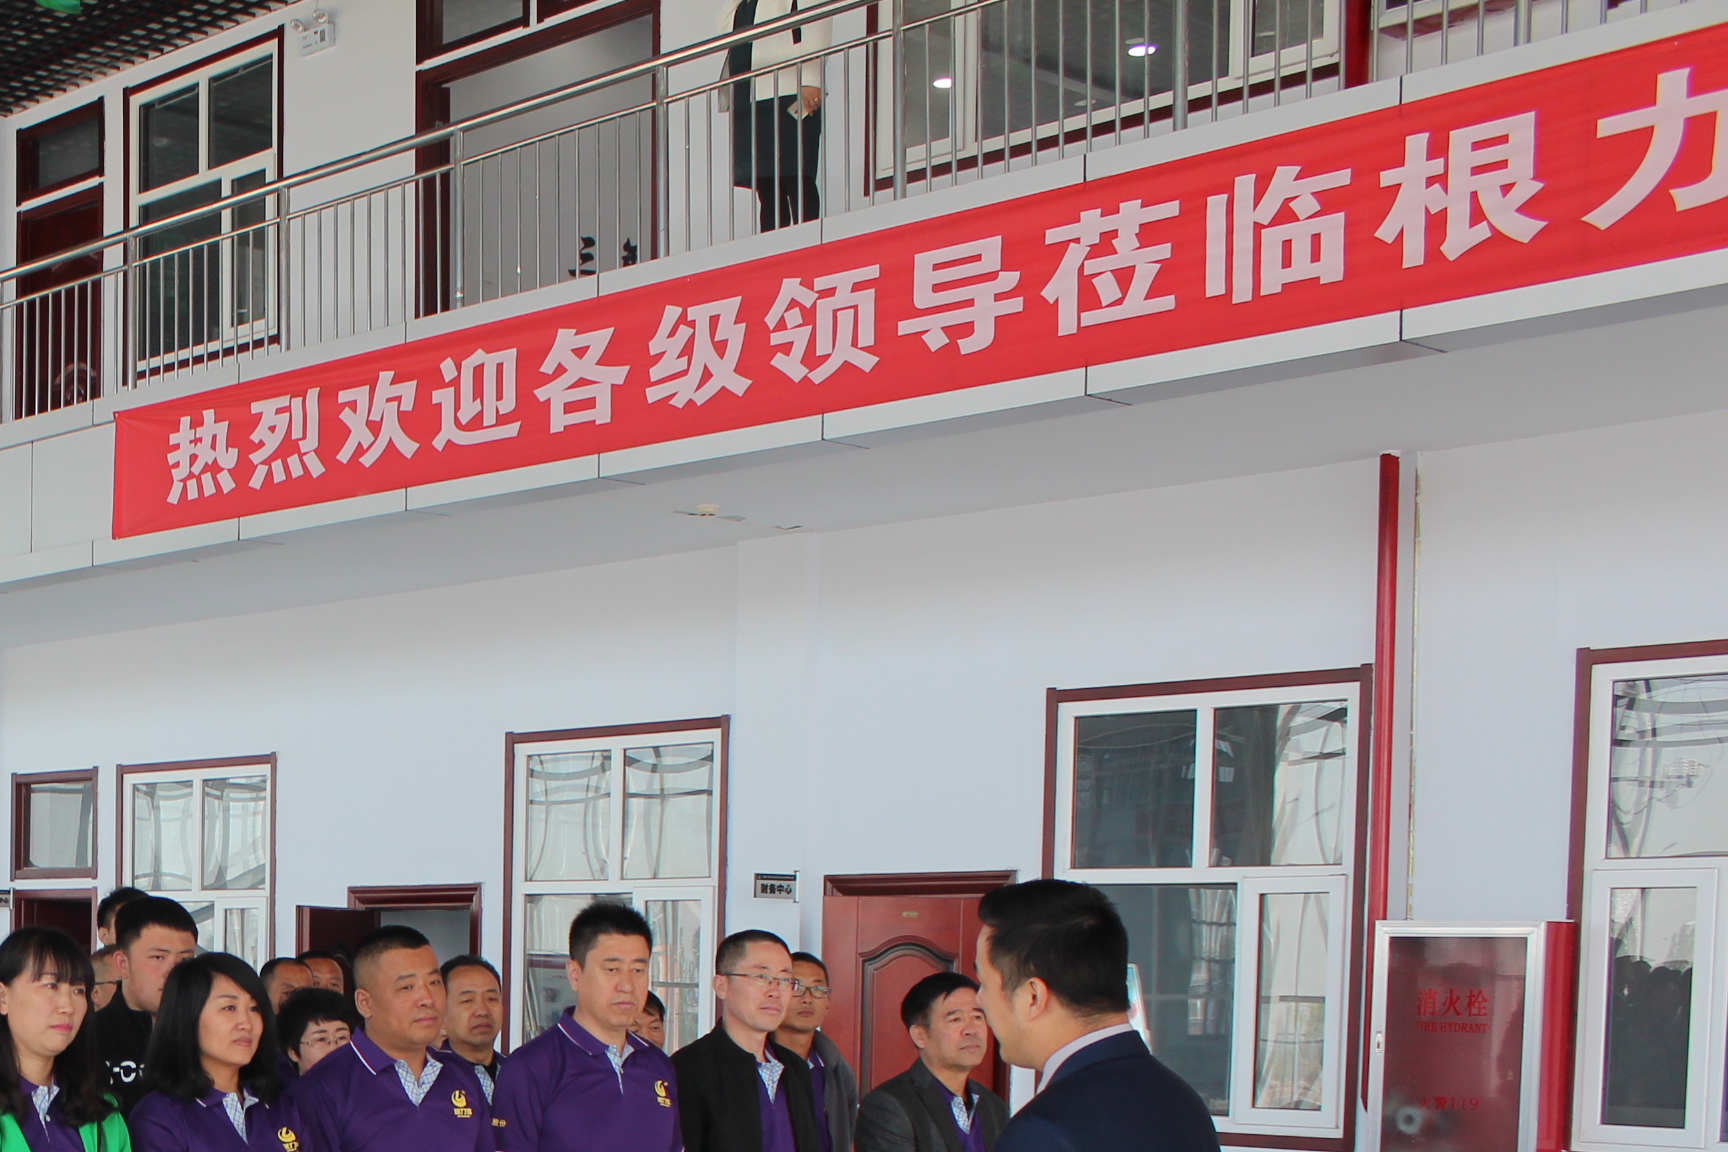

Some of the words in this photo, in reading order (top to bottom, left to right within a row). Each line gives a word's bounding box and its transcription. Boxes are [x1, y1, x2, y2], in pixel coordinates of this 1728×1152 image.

[167, 66, 1728, 506] 热烈欢迎各级领导莅临根力
[760, 883, 792, 895] 财务中心
[1416, 987, 1490, 1018] 消火栓
[1440, 1021, 1489, 1034] HYDRANT
